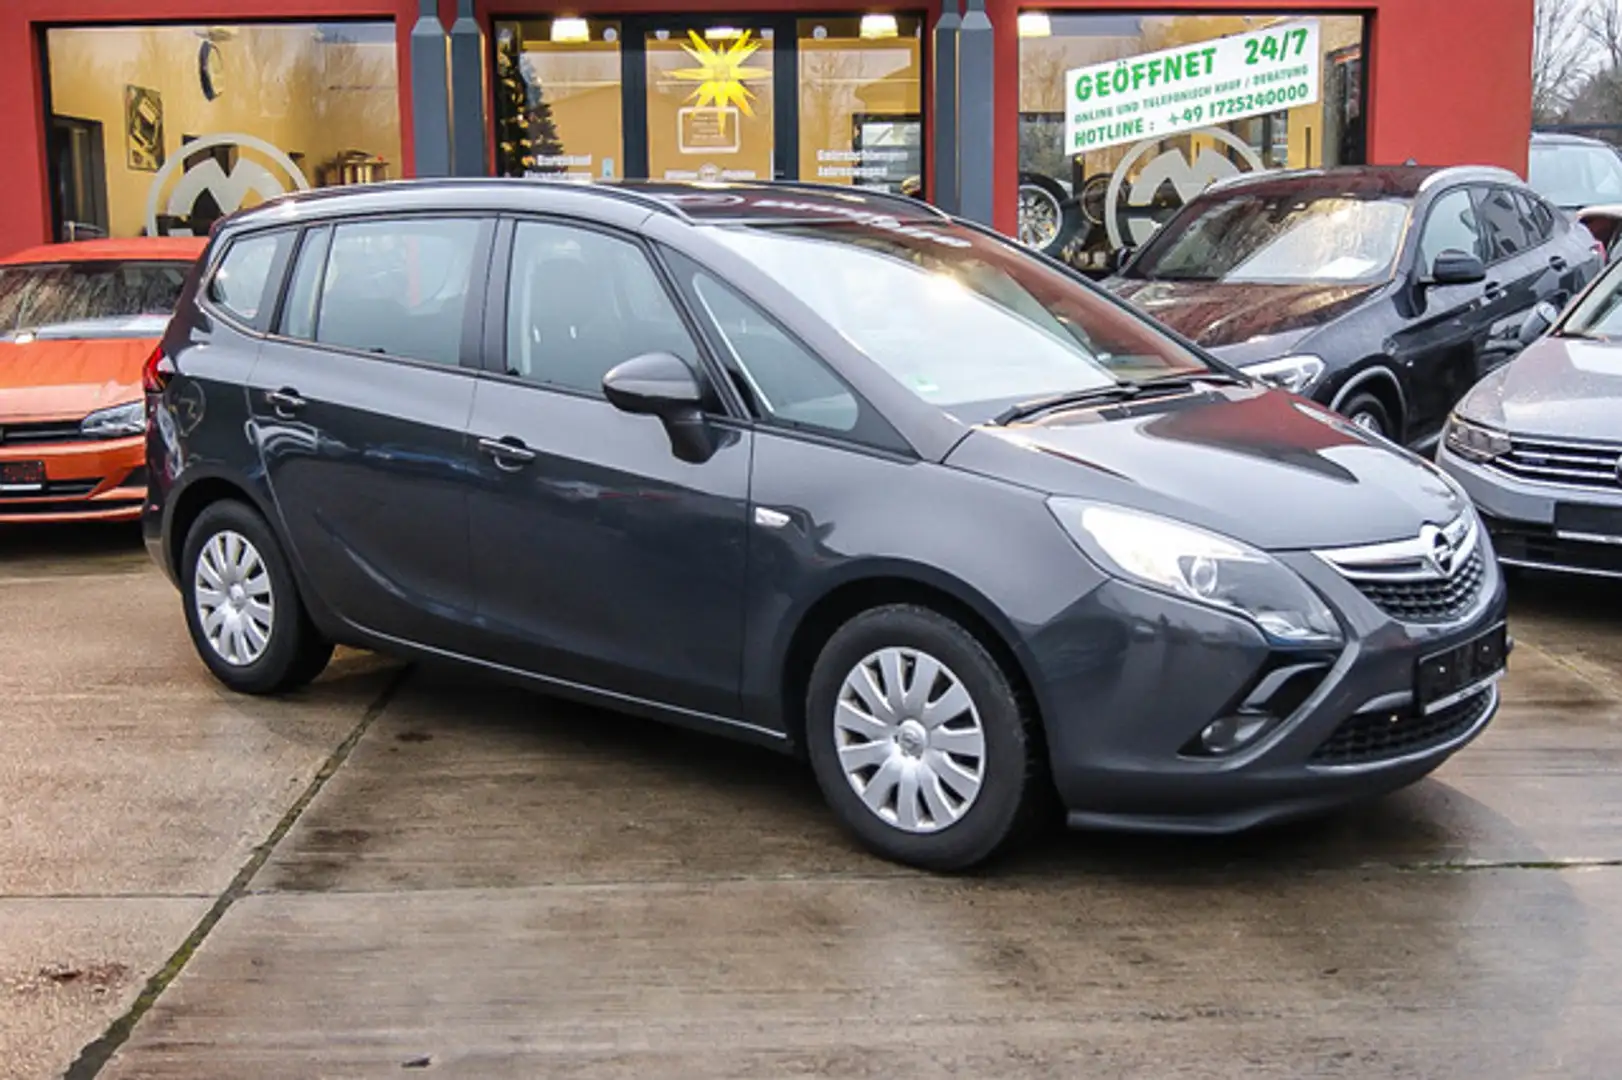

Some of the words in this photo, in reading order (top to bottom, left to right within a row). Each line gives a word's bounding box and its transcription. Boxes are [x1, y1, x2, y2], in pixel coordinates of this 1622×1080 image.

[1074, 107, 1113, 124] ONLINE
[1116, 102, 1139, 116] UND
[1143, 87, 1212, 109] TELEFONISCH
[1253, 64, 1309, 87] BERATUNG
[1075, 47, 1217, 101] GEÖFFNET
[1244, 28, 1308, 65] 24/7
[1074, 118, 1144, 148] HOTLINE
[1168, 105, 1204, 126] +49
